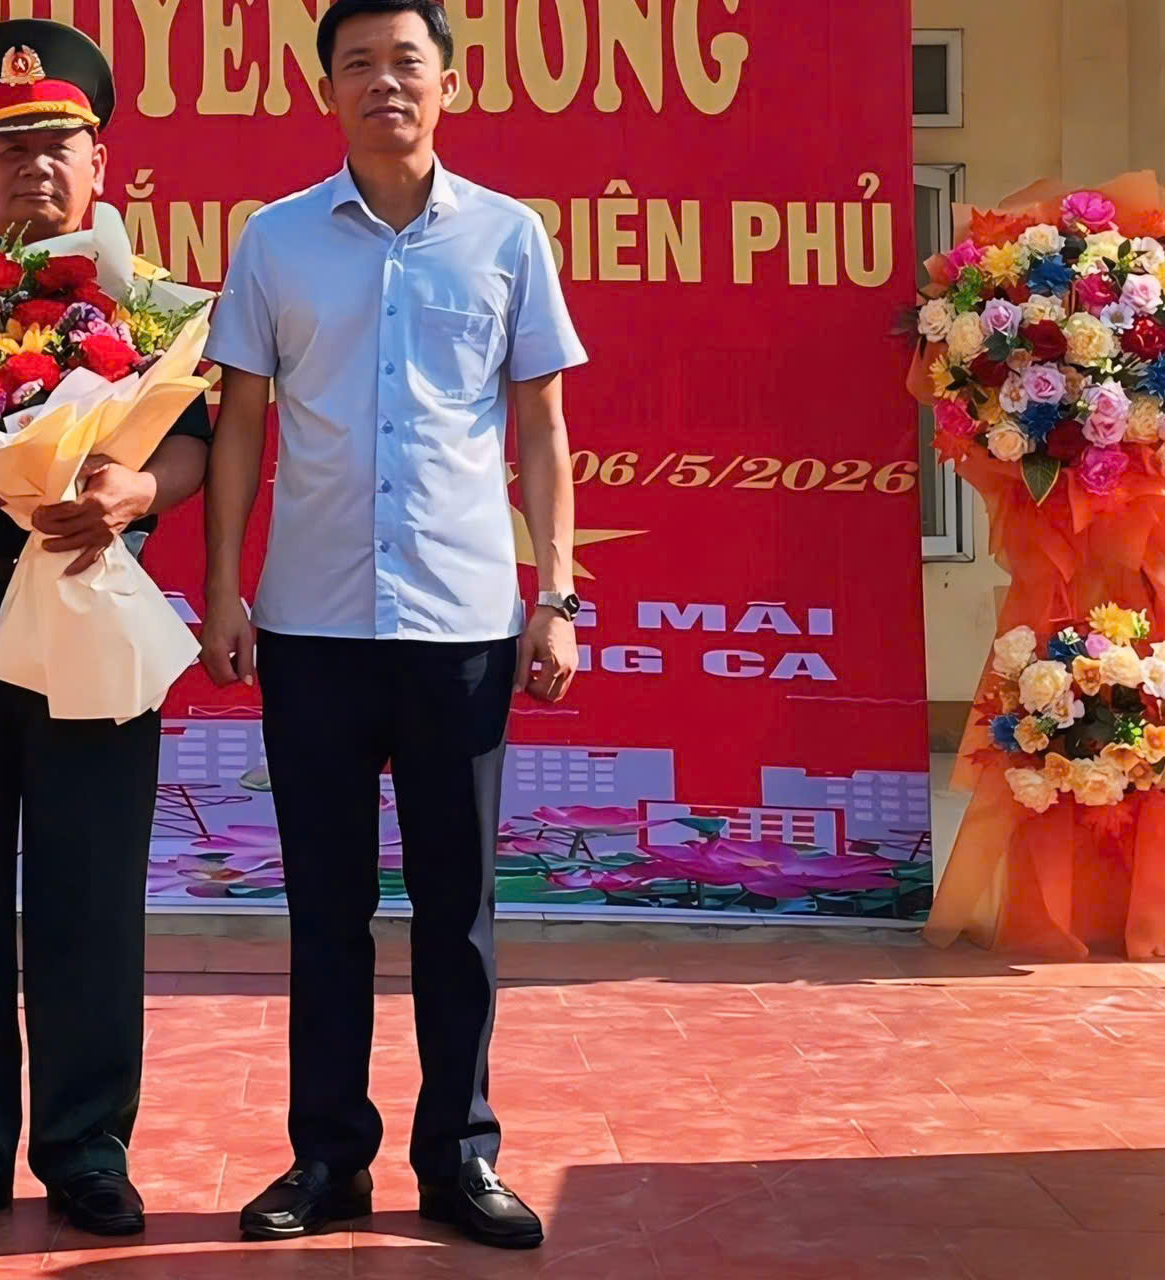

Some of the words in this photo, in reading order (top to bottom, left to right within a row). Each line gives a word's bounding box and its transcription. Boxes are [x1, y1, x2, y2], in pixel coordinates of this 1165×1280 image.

[731, 172, 894, 288] PHỦ
[637, 600, 834, 636] MÃI
[703, 649, 838, 681] CA
